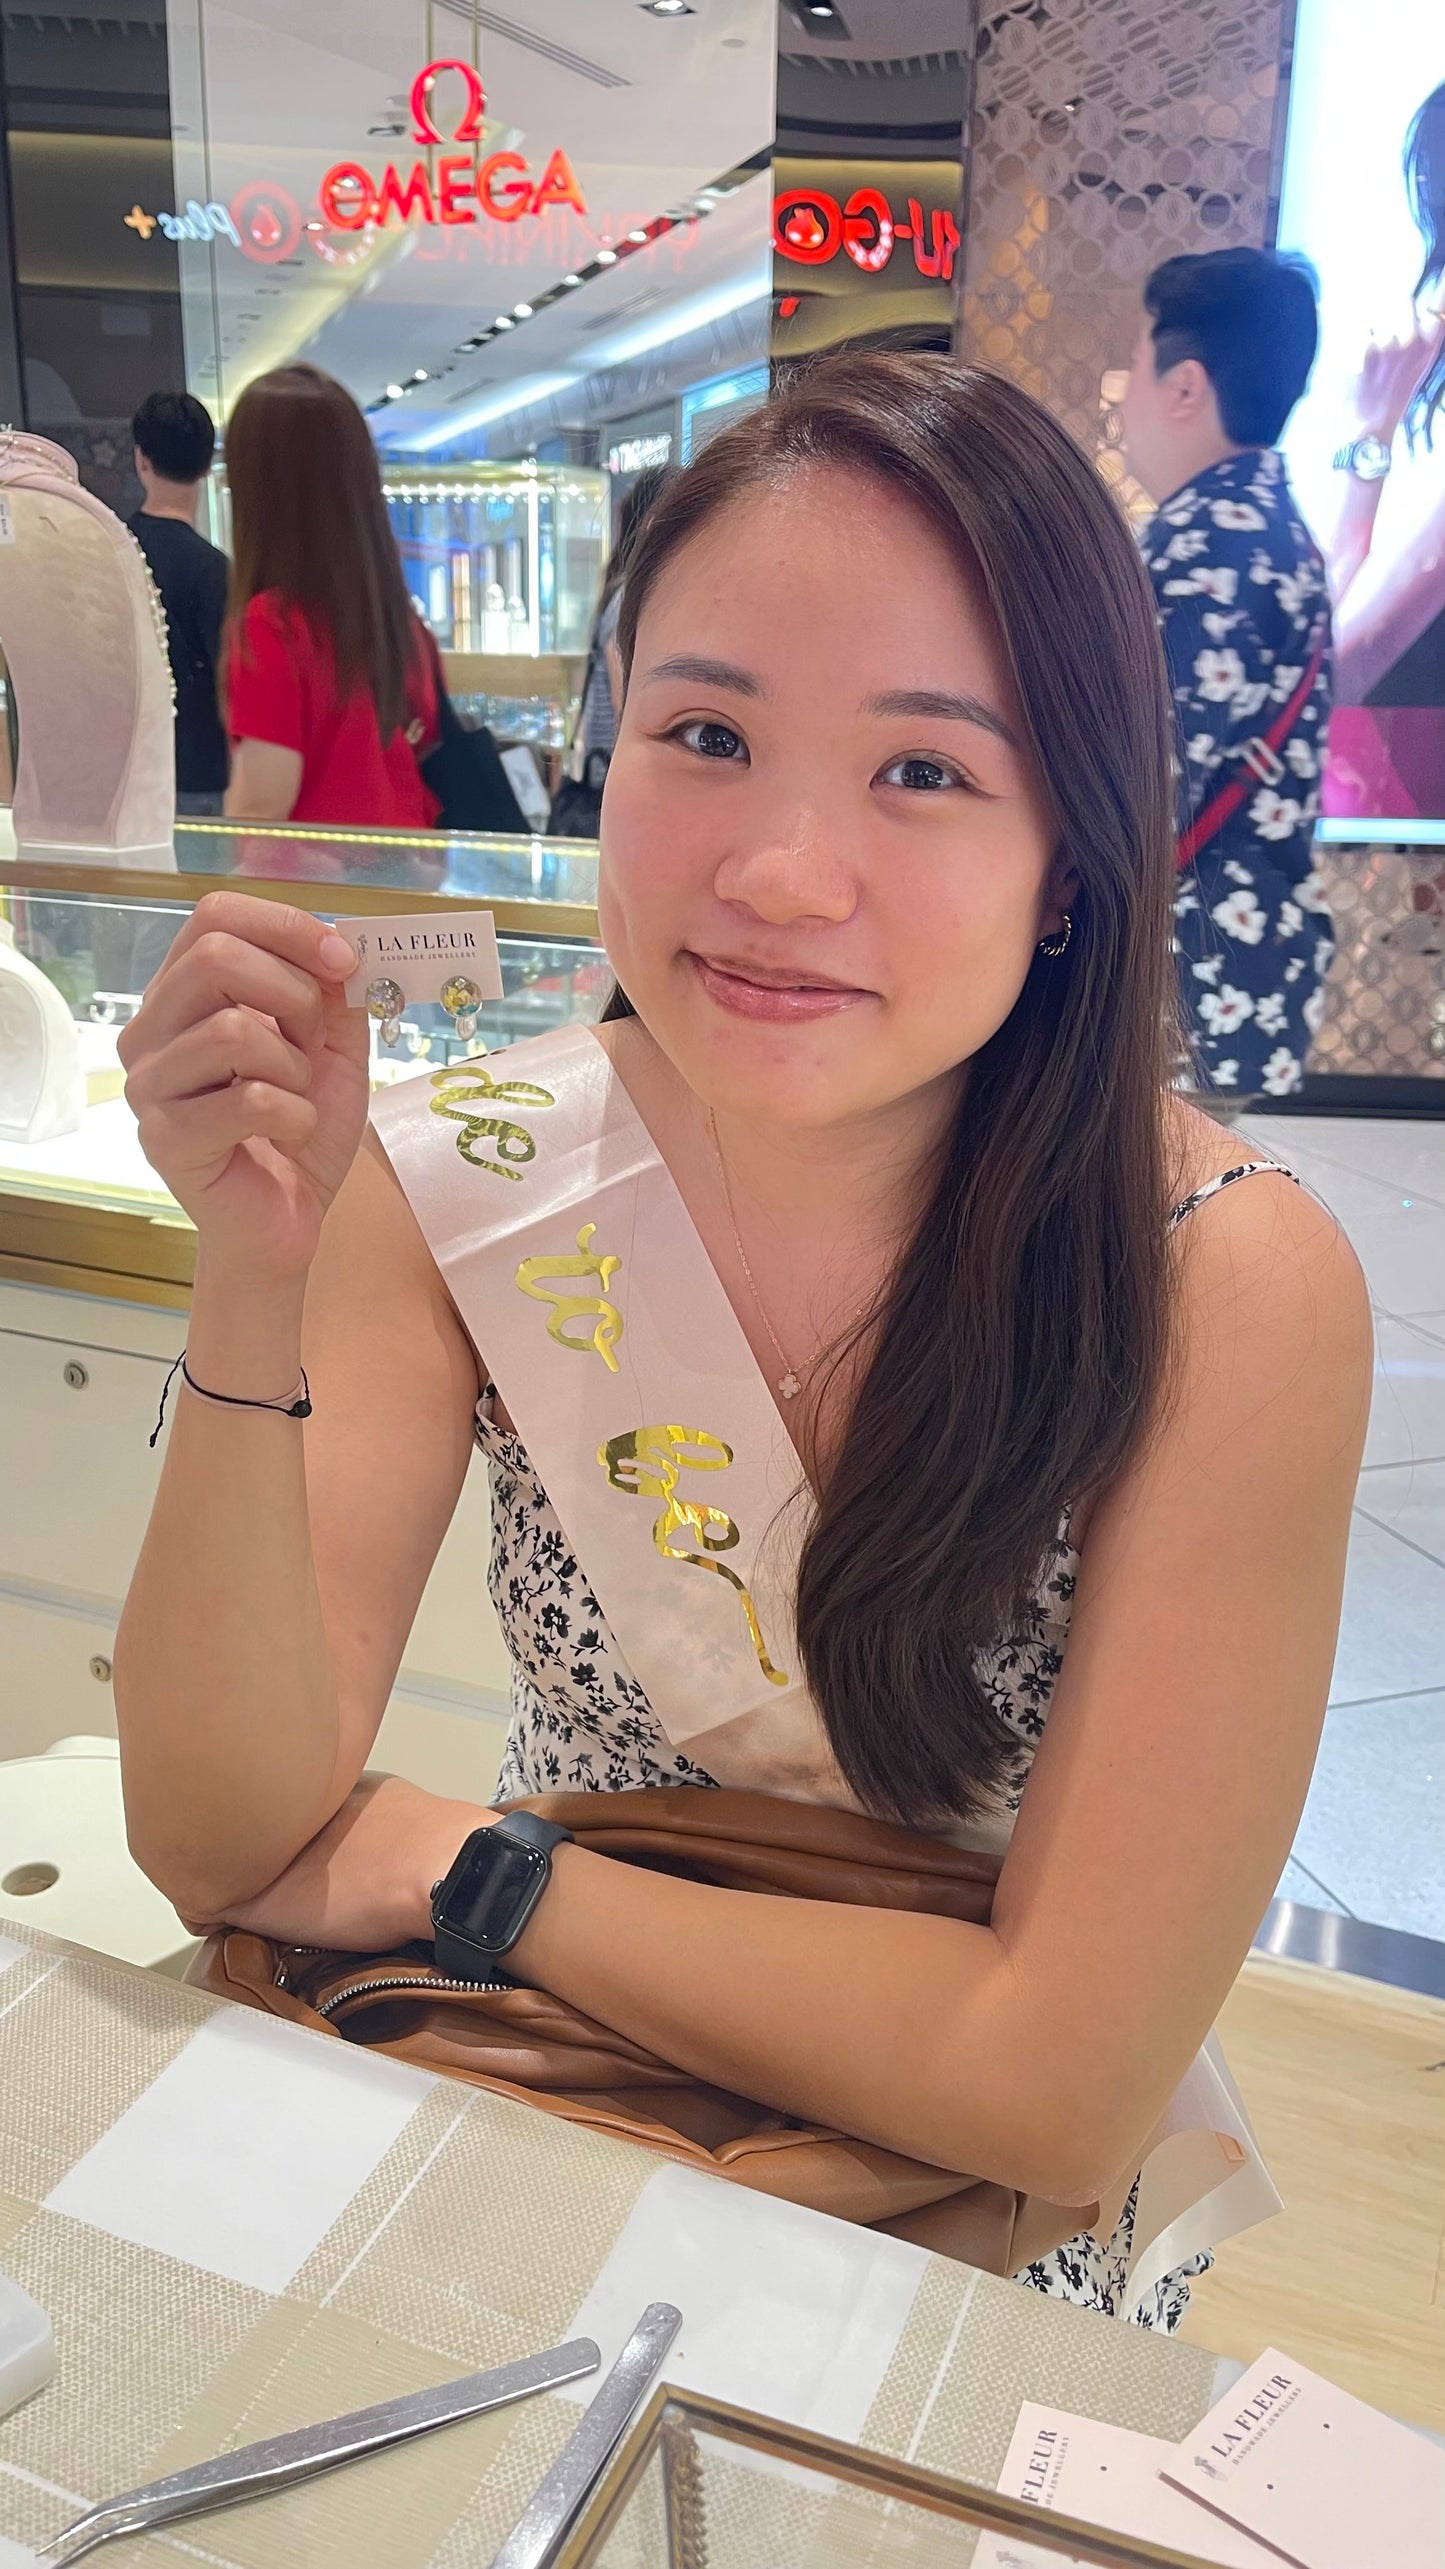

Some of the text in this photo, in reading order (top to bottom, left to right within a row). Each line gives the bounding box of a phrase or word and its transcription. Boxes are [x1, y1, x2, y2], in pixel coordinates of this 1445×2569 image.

[319, 148, 587, 232] OMEGA
[377, 932, 476, 951] LA FLEUR
[380, 951, 477, 962] HANDMADE JEWELLERY
[515, 1221, 624, 1373] to
[595, 1424, 788, 1686] be
[1210, 2375, 1292, 2458] LA FLEUR
[1020, 2429, 1058, 2503] FLEUR
